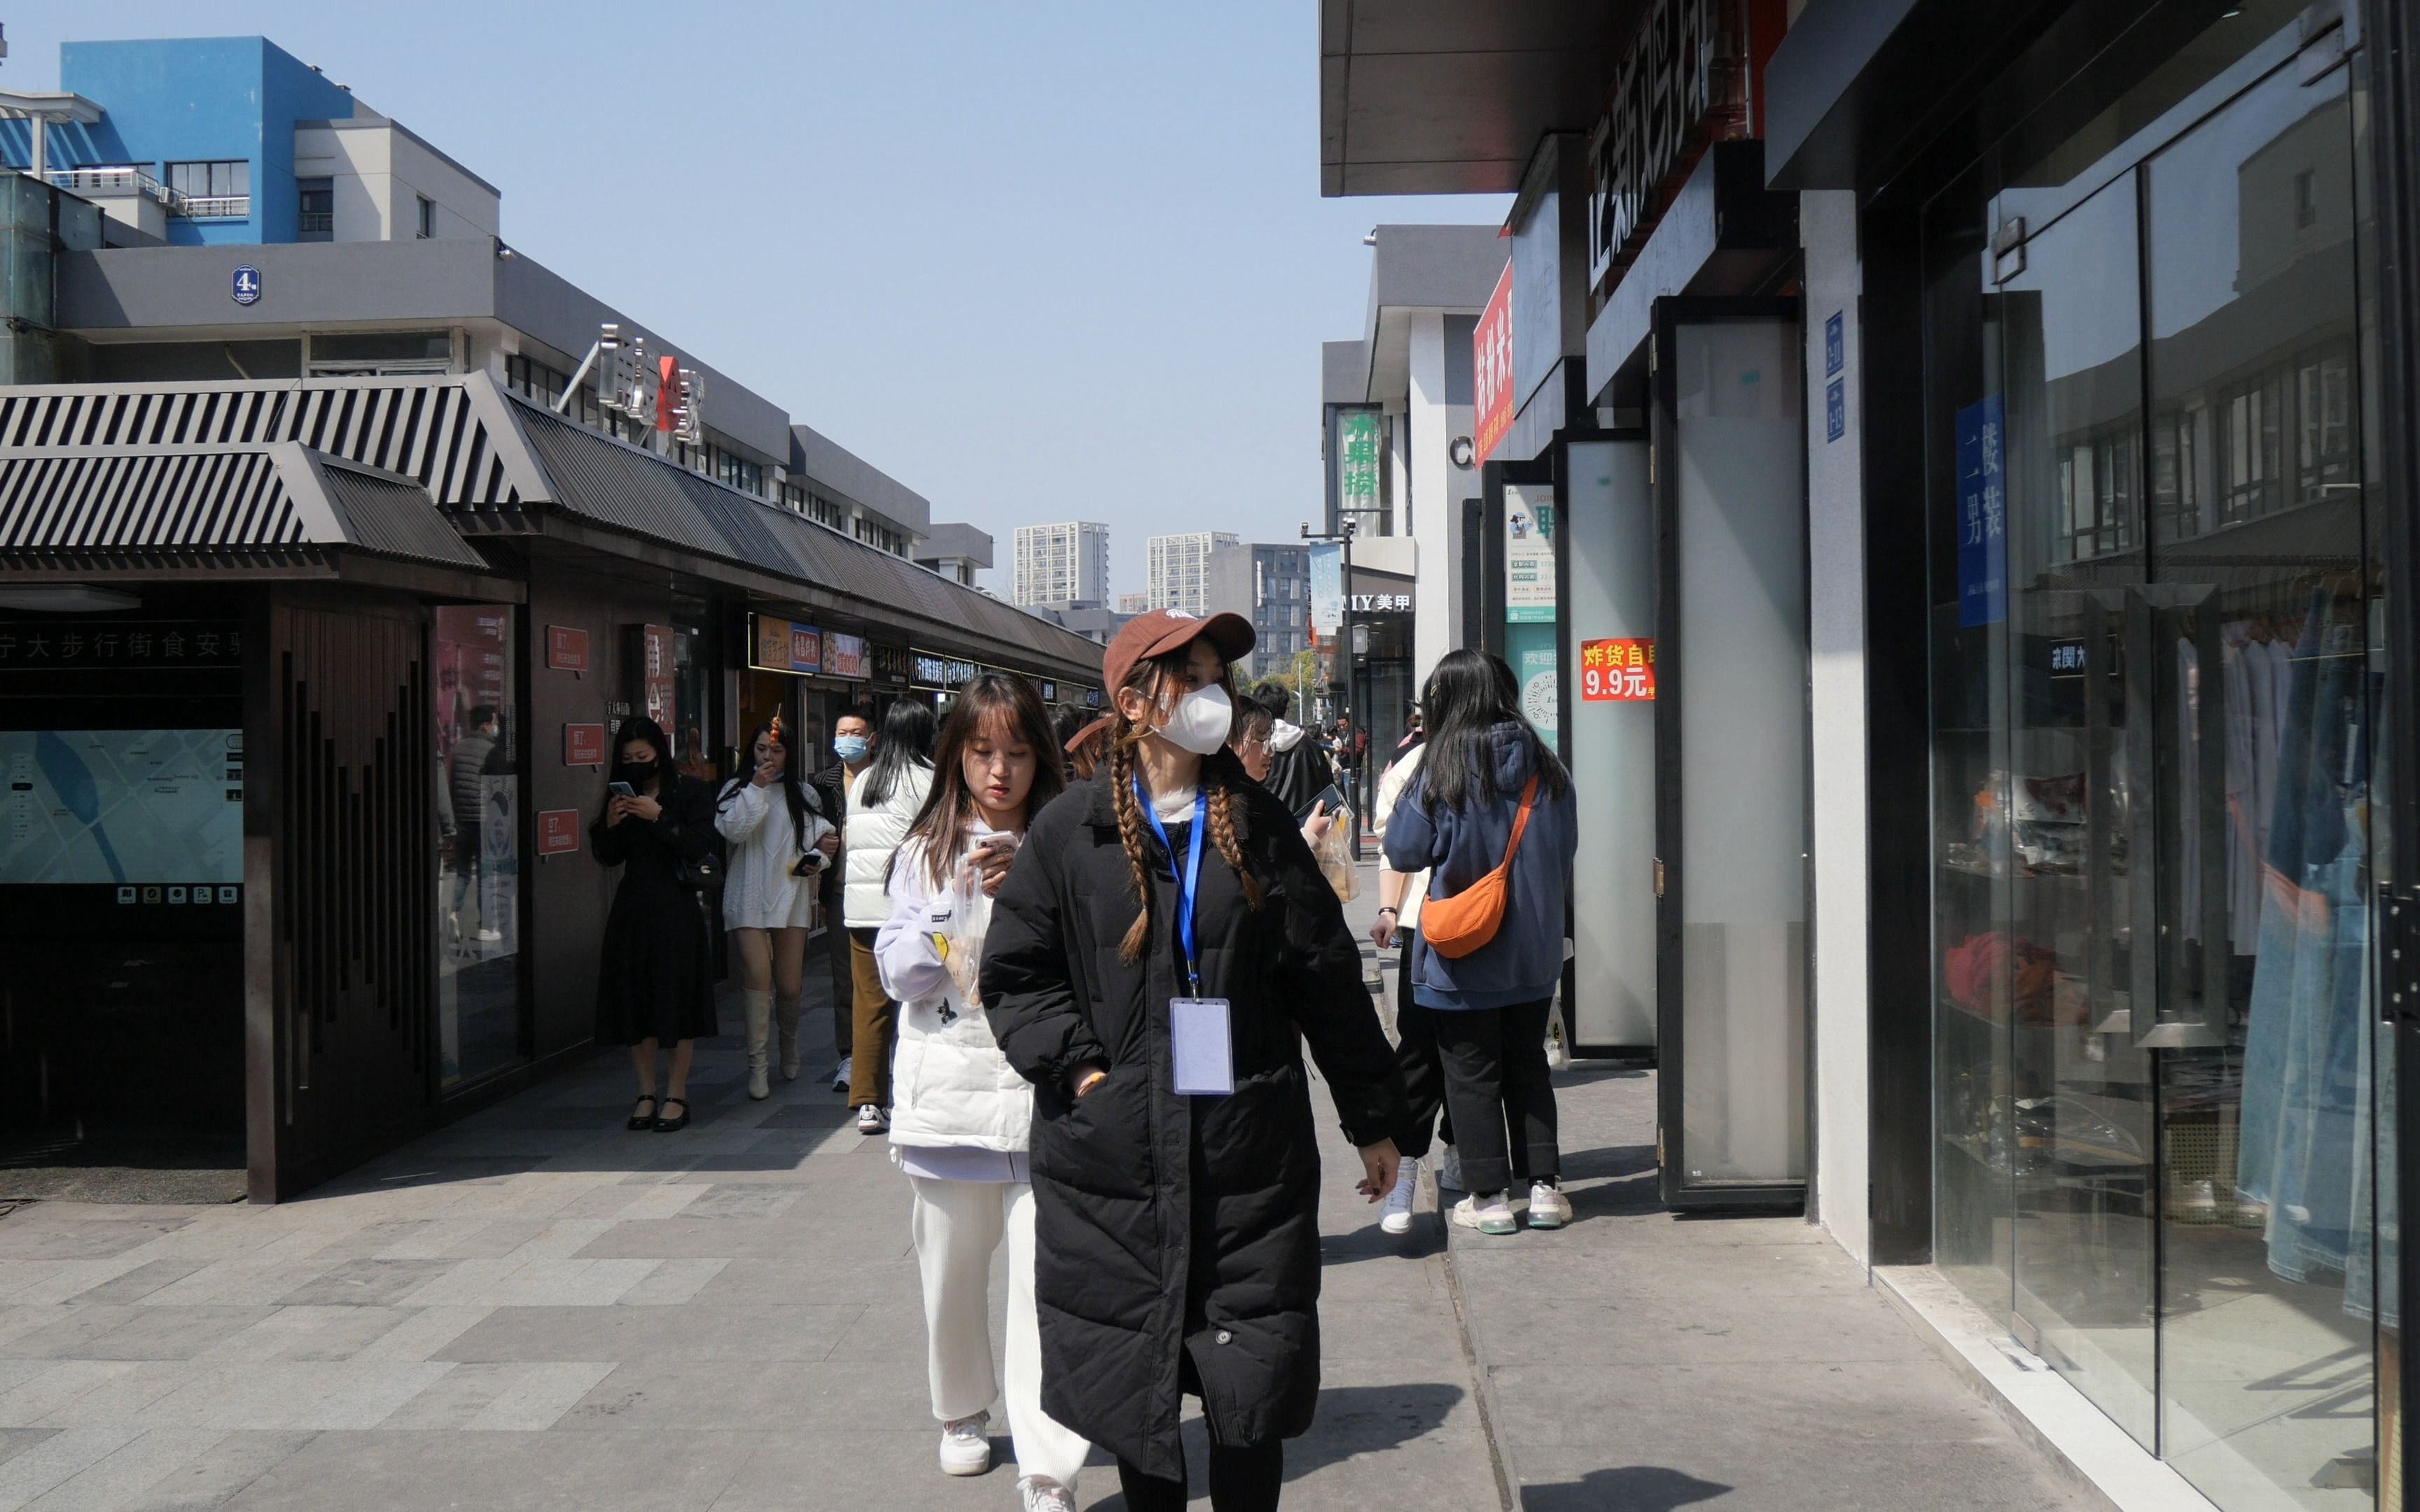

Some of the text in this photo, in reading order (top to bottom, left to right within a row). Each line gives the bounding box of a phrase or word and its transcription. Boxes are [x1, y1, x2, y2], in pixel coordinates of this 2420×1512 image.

[1966, 484, 2001, 545] 男装
[1377, 594, 1411, 610] 美甲
[1524, 652, 1557, 665] 欢迎
[1585, 667, 1647, 698] 9.9元
